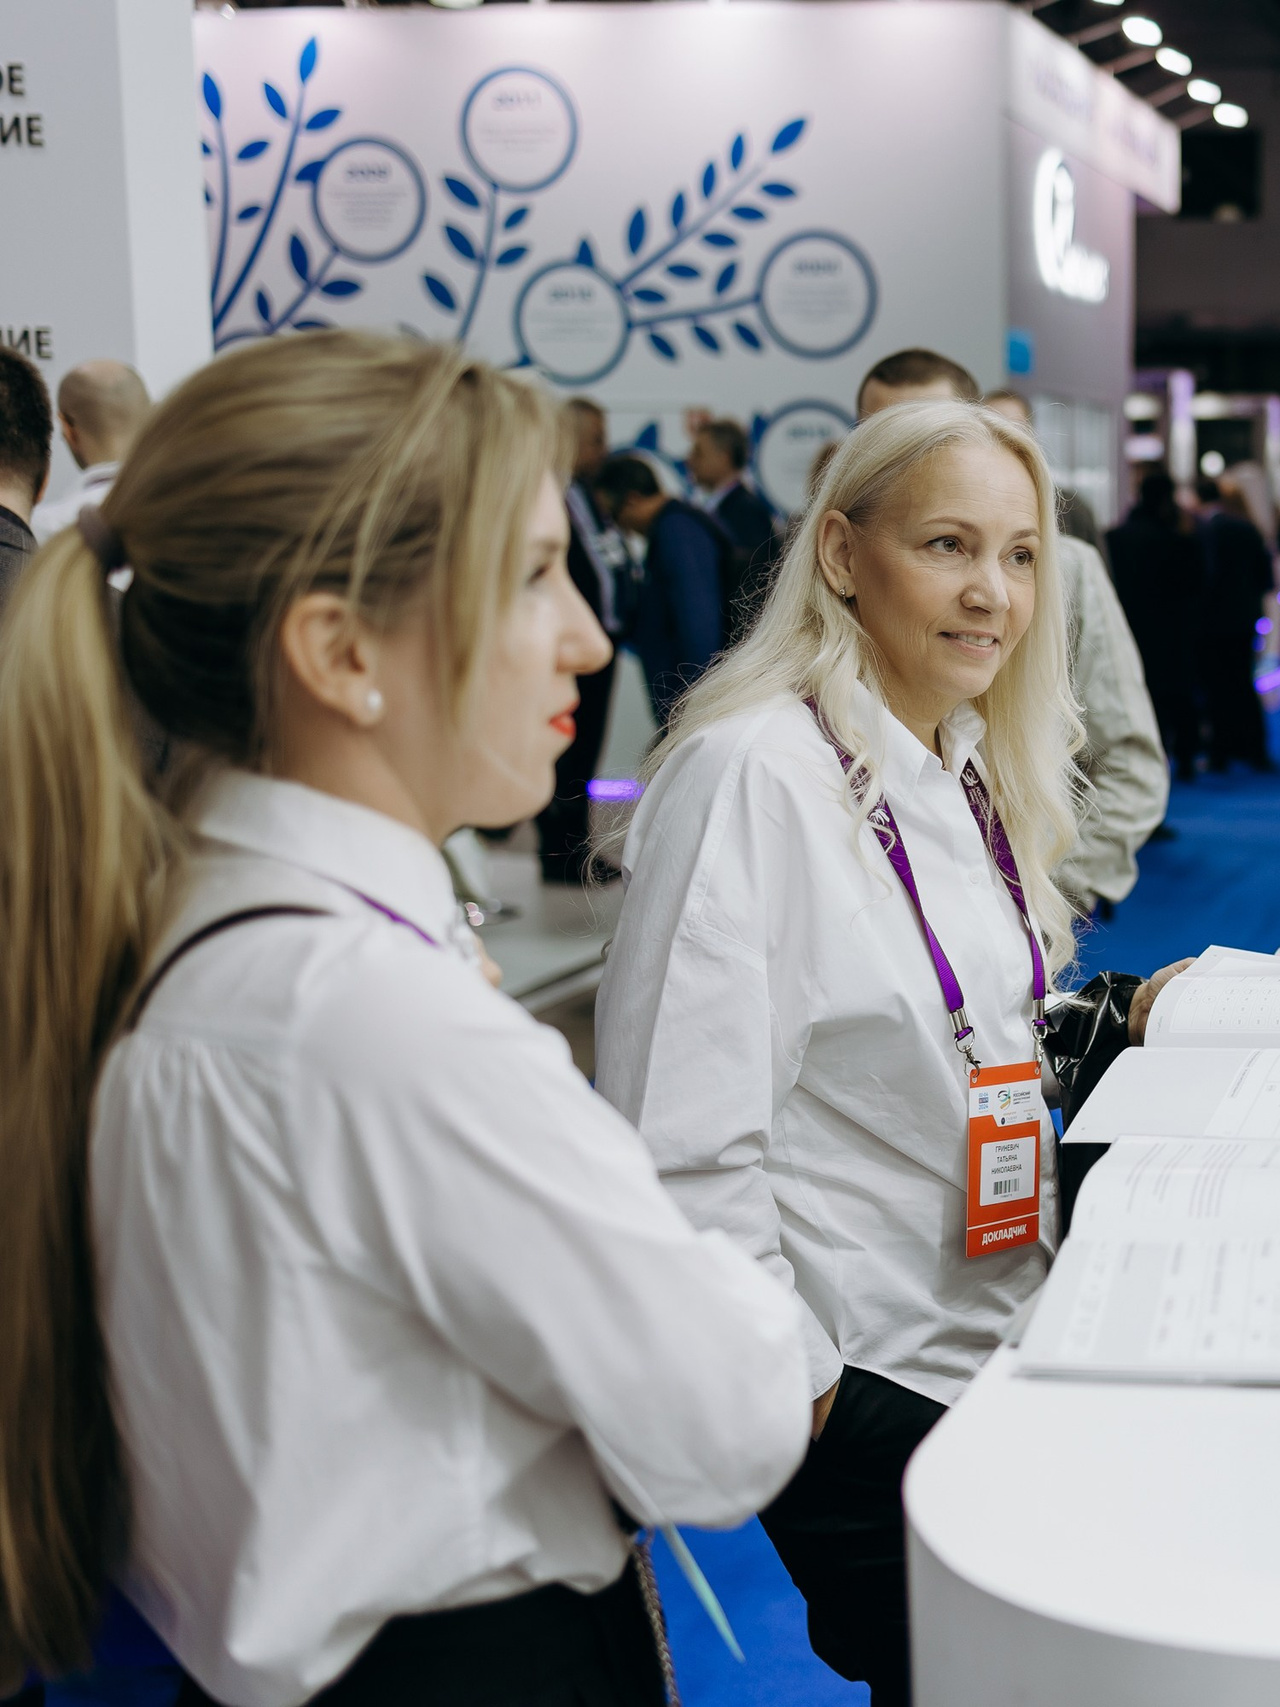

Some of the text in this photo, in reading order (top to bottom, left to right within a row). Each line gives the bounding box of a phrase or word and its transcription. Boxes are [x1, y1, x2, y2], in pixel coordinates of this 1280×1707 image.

[0, 328, 53, 360] ИЕ
[995, 1143, 1020, 1153] ГРИНЕВИЧ
[996, 1154, 1018, 1163] ТАТЬЯНА
[991, 1163, 1023, 1175] НИКОЛАЕВНА
[981, 1224, 1028, 1246] ДОКЛАДЧИК
